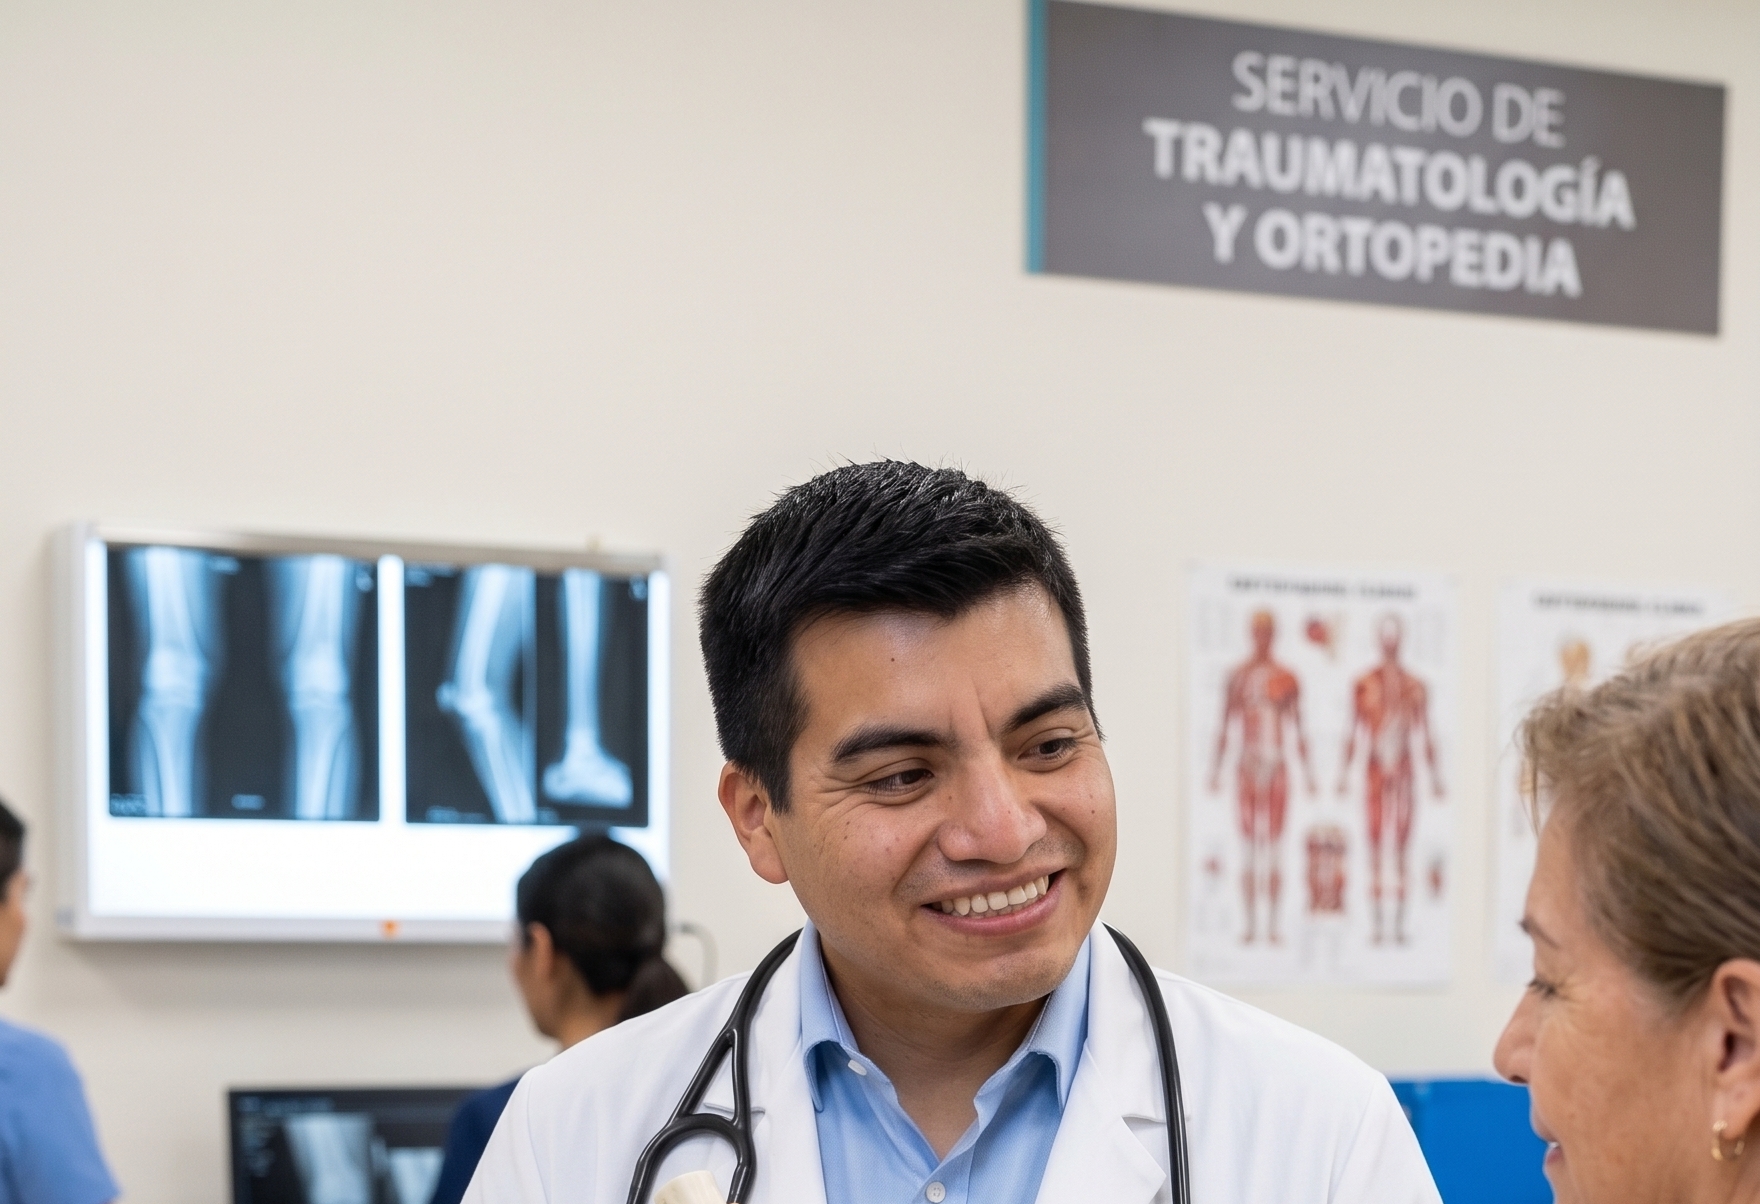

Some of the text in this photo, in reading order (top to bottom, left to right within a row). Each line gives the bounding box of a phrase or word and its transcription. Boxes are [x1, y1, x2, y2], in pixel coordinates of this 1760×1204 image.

[1232, 51, 1566, 148] SERVICIO DE
[1143, 118, 1636, 230] TRAUMATOLOGÍA
[1203, 204, 1582, 297] Y ORTOPEDIA
